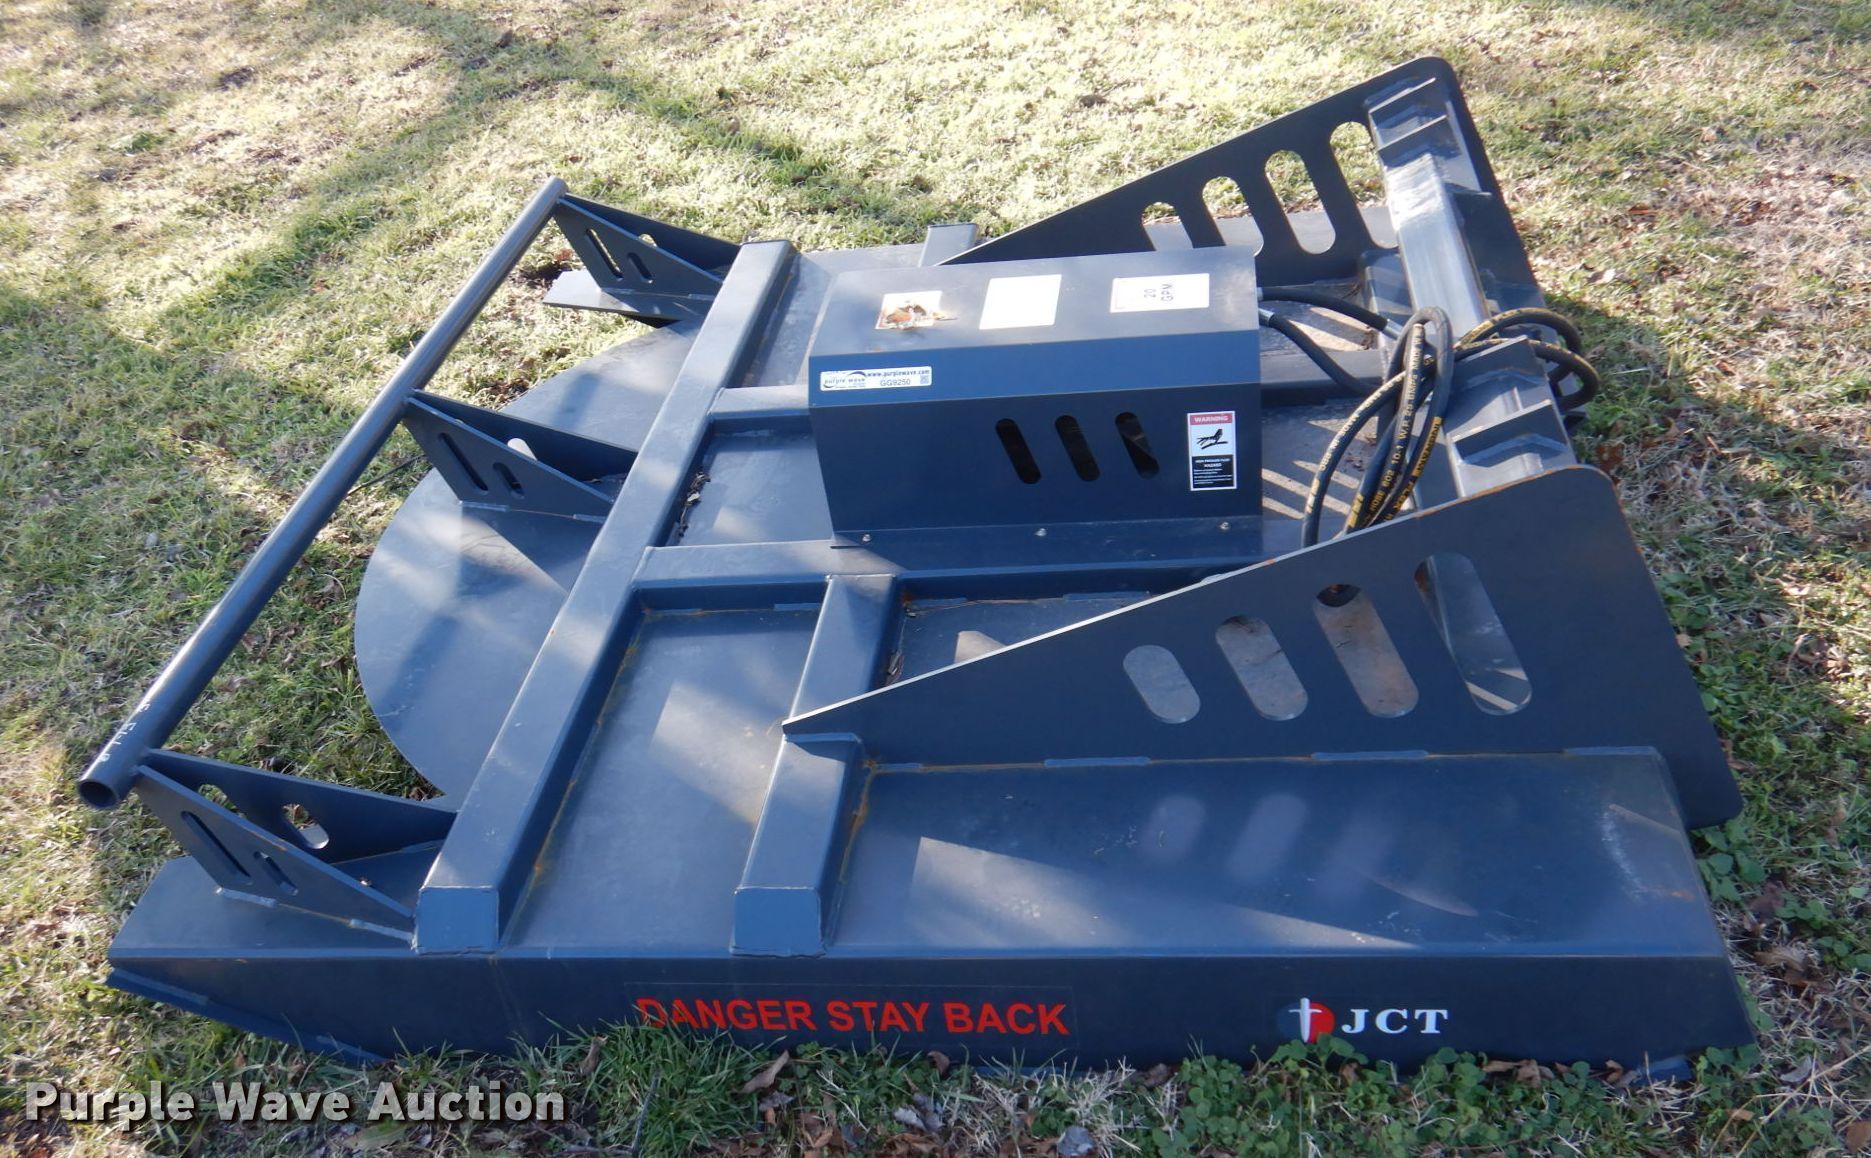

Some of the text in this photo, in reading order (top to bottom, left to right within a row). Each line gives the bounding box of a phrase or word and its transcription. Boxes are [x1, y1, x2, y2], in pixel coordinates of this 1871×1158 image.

[1194, 415, 1229, 423] WARNING
[635, 998, 1070, 1035] DANGER STAY BACK
[1341, 1008, 1448, 1034] JCT
